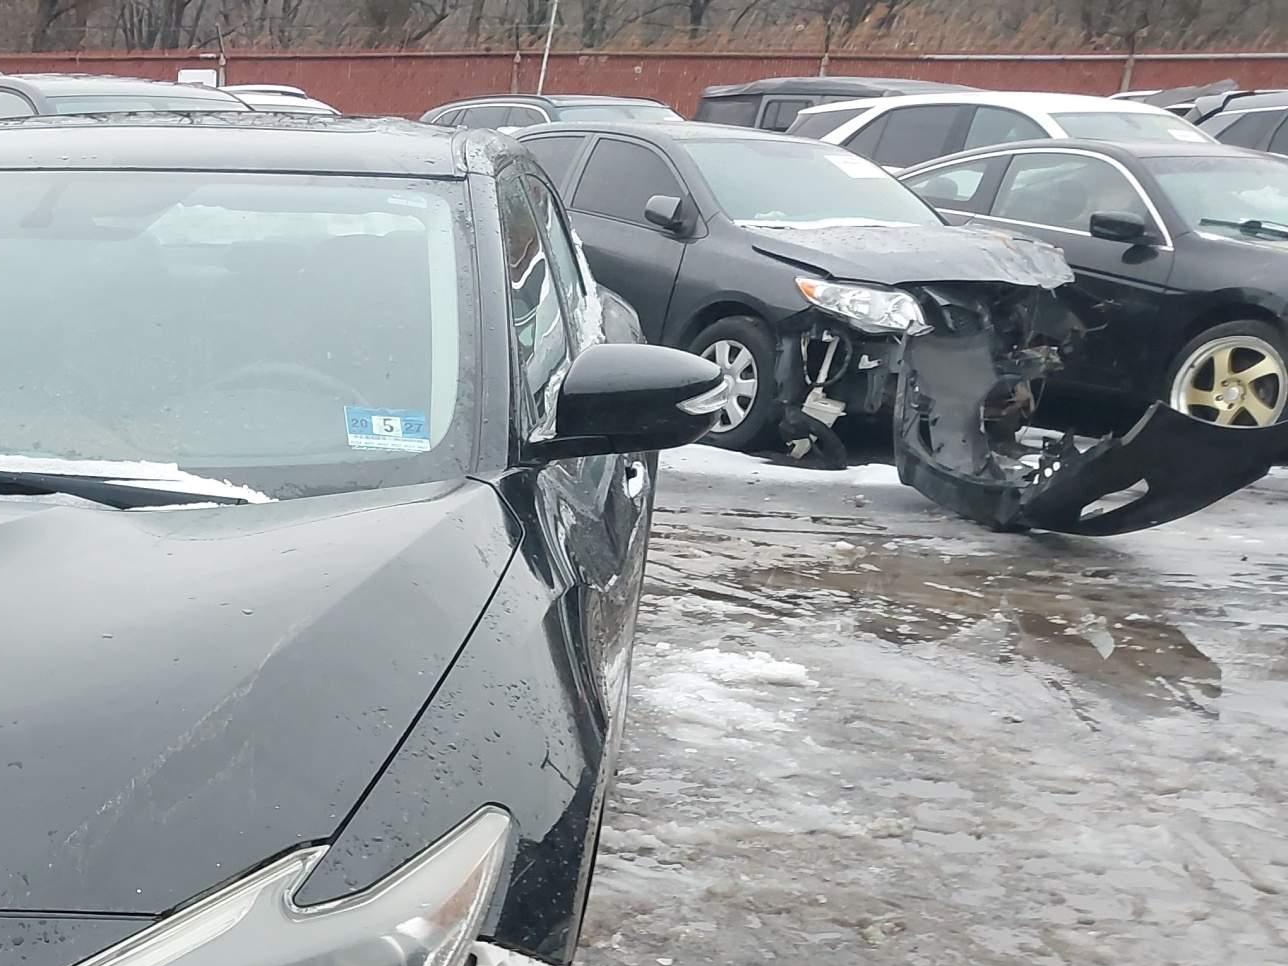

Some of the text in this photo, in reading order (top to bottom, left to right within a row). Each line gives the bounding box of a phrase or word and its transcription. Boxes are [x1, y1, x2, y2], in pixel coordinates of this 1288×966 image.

[351, 418, 424, 433] 20 5 27
